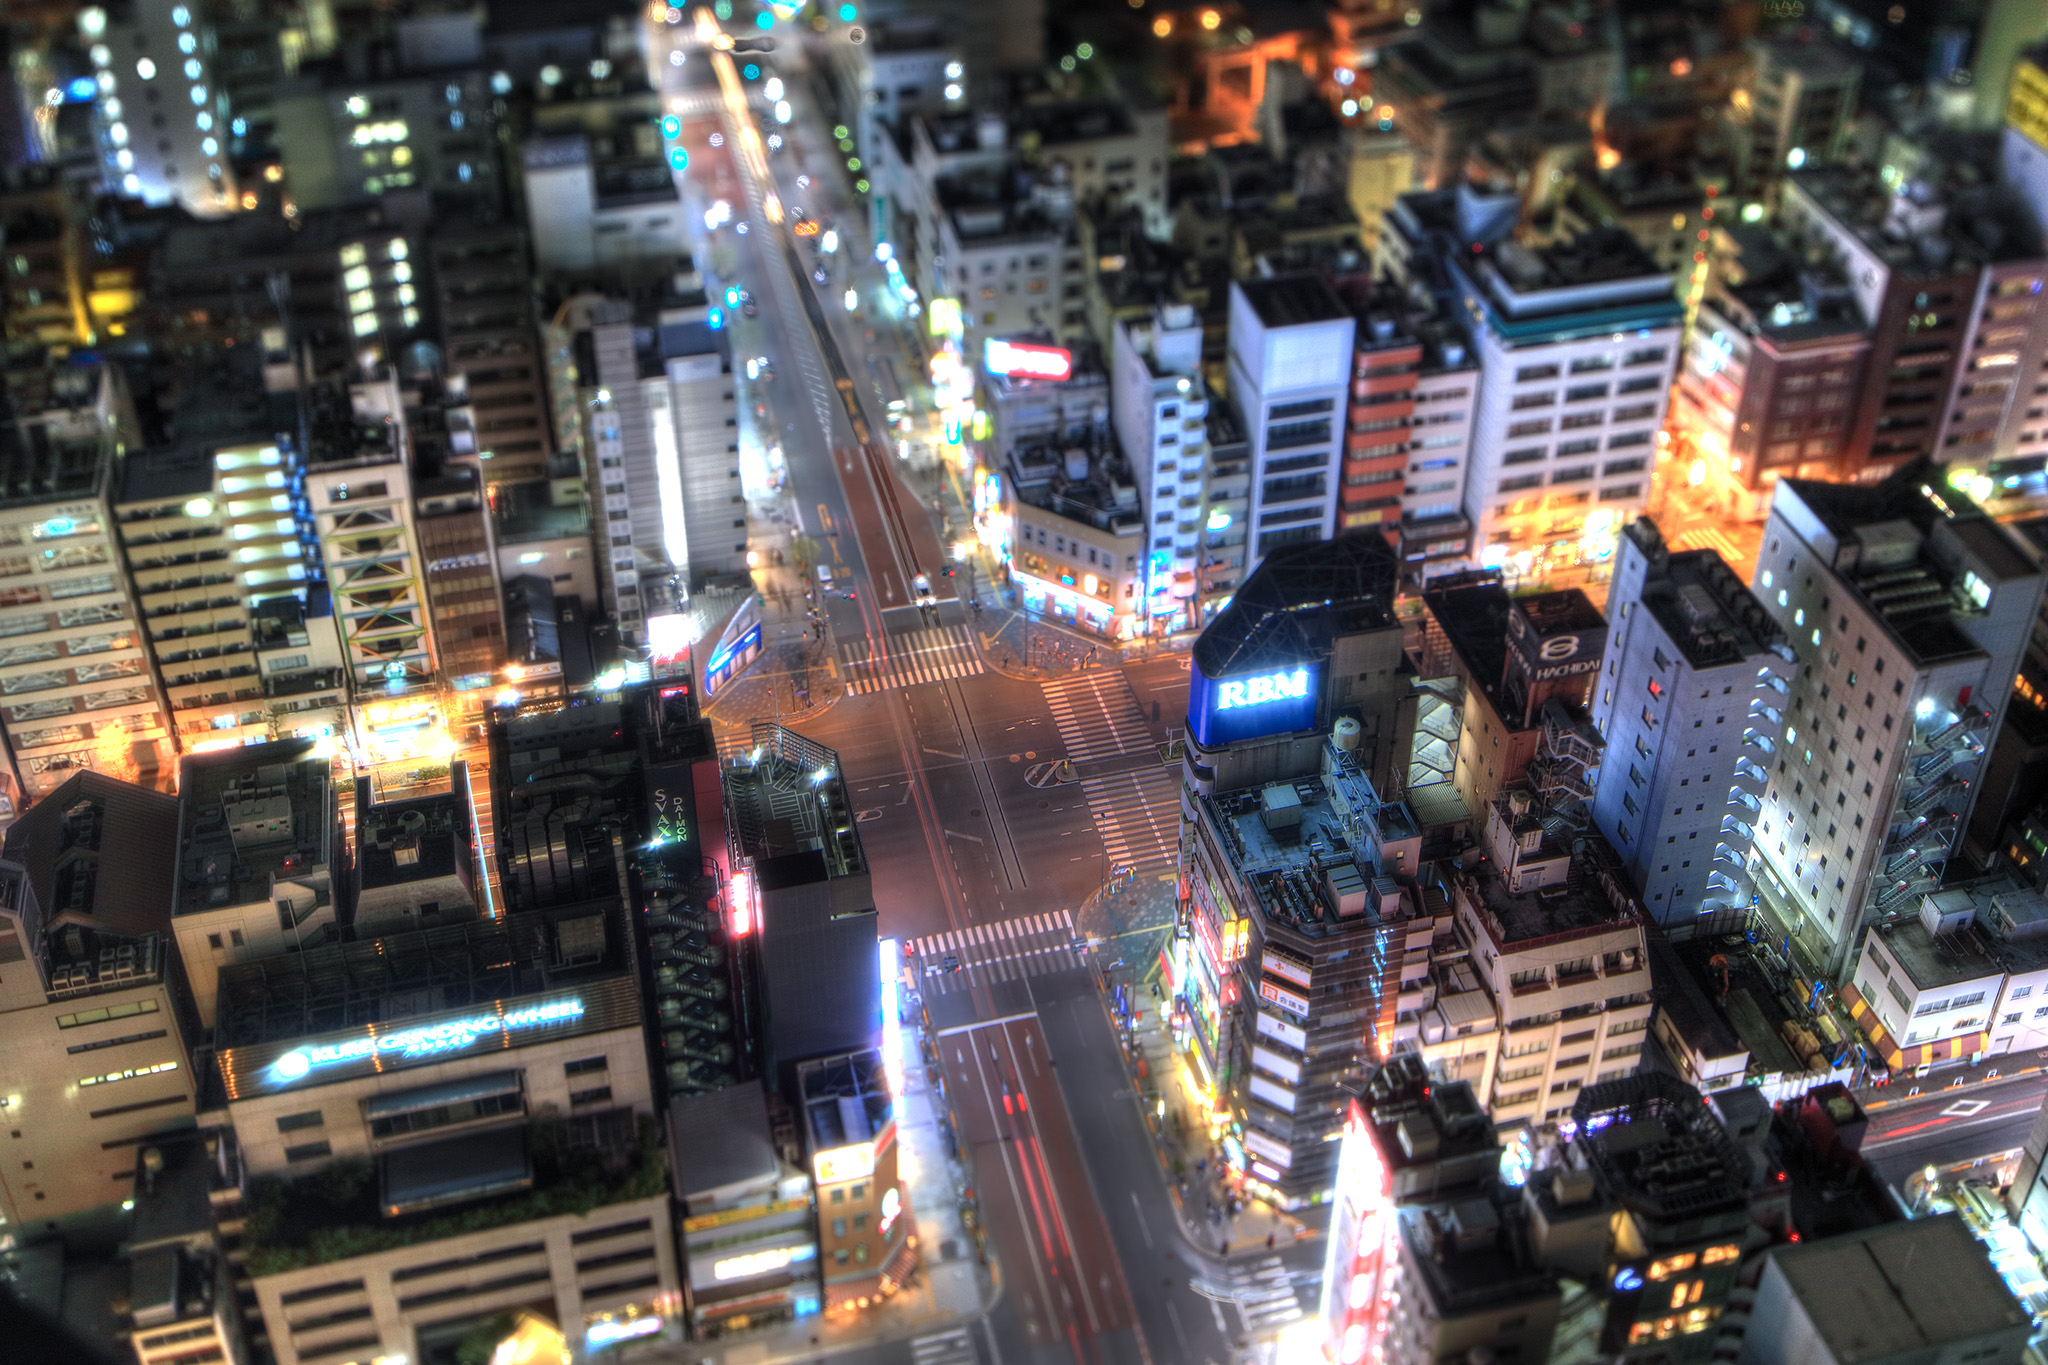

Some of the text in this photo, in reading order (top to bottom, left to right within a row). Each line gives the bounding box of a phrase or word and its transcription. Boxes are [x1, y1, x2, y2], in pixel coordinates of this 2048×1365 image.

[1218, 669, 1310, 711] RBM
[1536, 659, 1601, 680] HACHIDAI
[654, 788, 671, 839] SVAX
[673, 797, 688, 843] DAIMON
[311, 1001, 584, 1064] KURE GRINDING WHEEL
